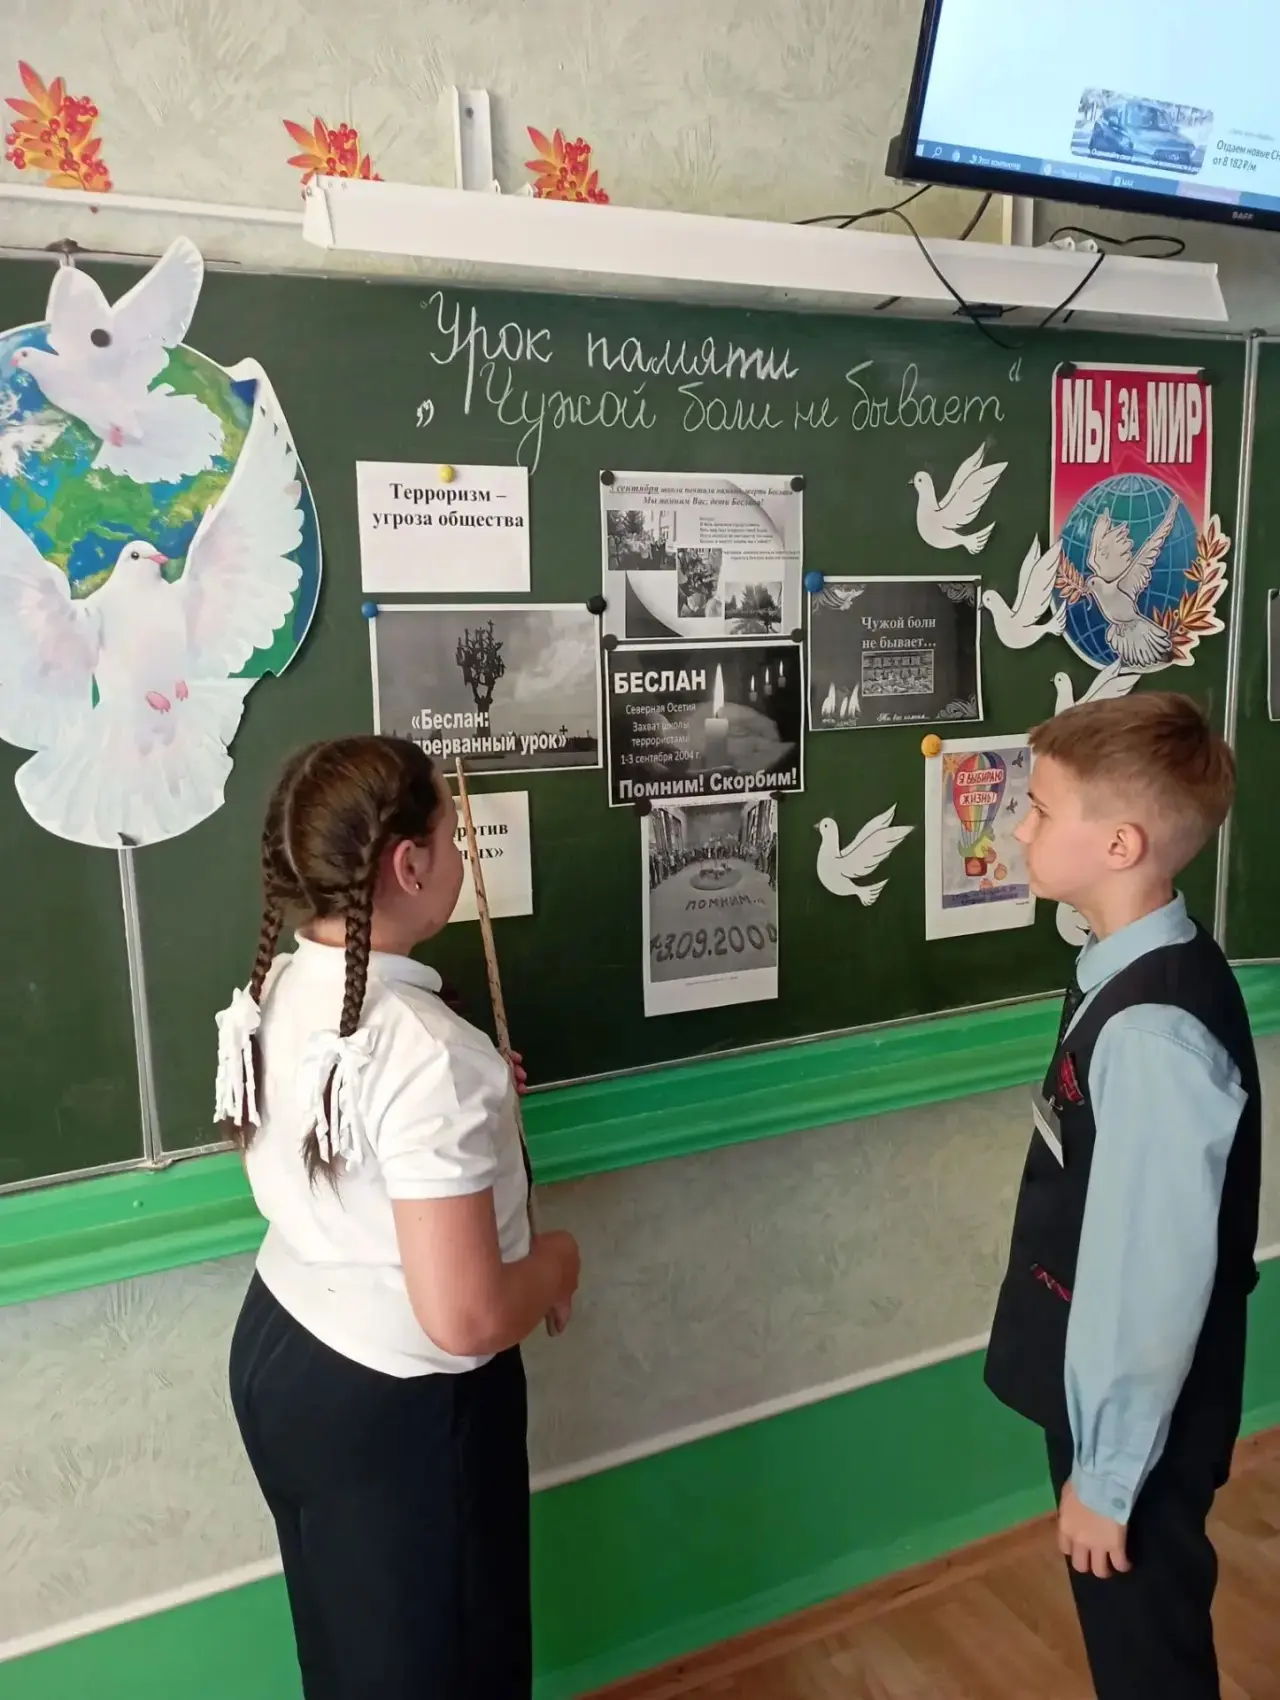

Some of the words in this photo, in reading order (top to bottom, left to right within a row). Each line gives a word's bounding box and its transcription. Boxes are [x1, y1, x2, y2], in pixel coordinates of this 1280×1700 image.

[429, 291, 553, 414] Урок
[587, 331, 800, 380] памяти
[678, 382, 784, 432] боли
[795, 397, 838, 430] не
[1061, 378, 1112, 464] МЫ
[1117, 388, 1140, 442] ЗА
[1146, 381, 1203, 464] МИР
[389, 483, 491, 505] Терроризм
[372, 511, 433, 530] угроза
[438, 510, 524, 528] общества
[861, 616, 905, 632] Чужой
[907, 615, 937, 629] боли
[862, 638, 877, 649] не
[614, 669, 706, 694] БЕСЛАН
[625, 704, 666, 715] Северная
[667, 701, 696, 713] Осетия
[411, 708, 490, 730] «Беслан:
[632, 721, 661, 732] Захват
[520, 733, 567, 755] урок»
[620, 754, 634, 765] 1-3
[635, 752, 673, 764] сентября
[674, 750, 694, 761] 2004
[619, 774, 705, 799] Помним!
[709, 767, 797, 793] Скорбим!
[958, 771, 964, 784] Я
[966, 770, 1003, 785] ВЫБИРАЮ
[962, 792, 996, 805] ЖИЗНЬ!
[454, 824, 508, 842] ртив
